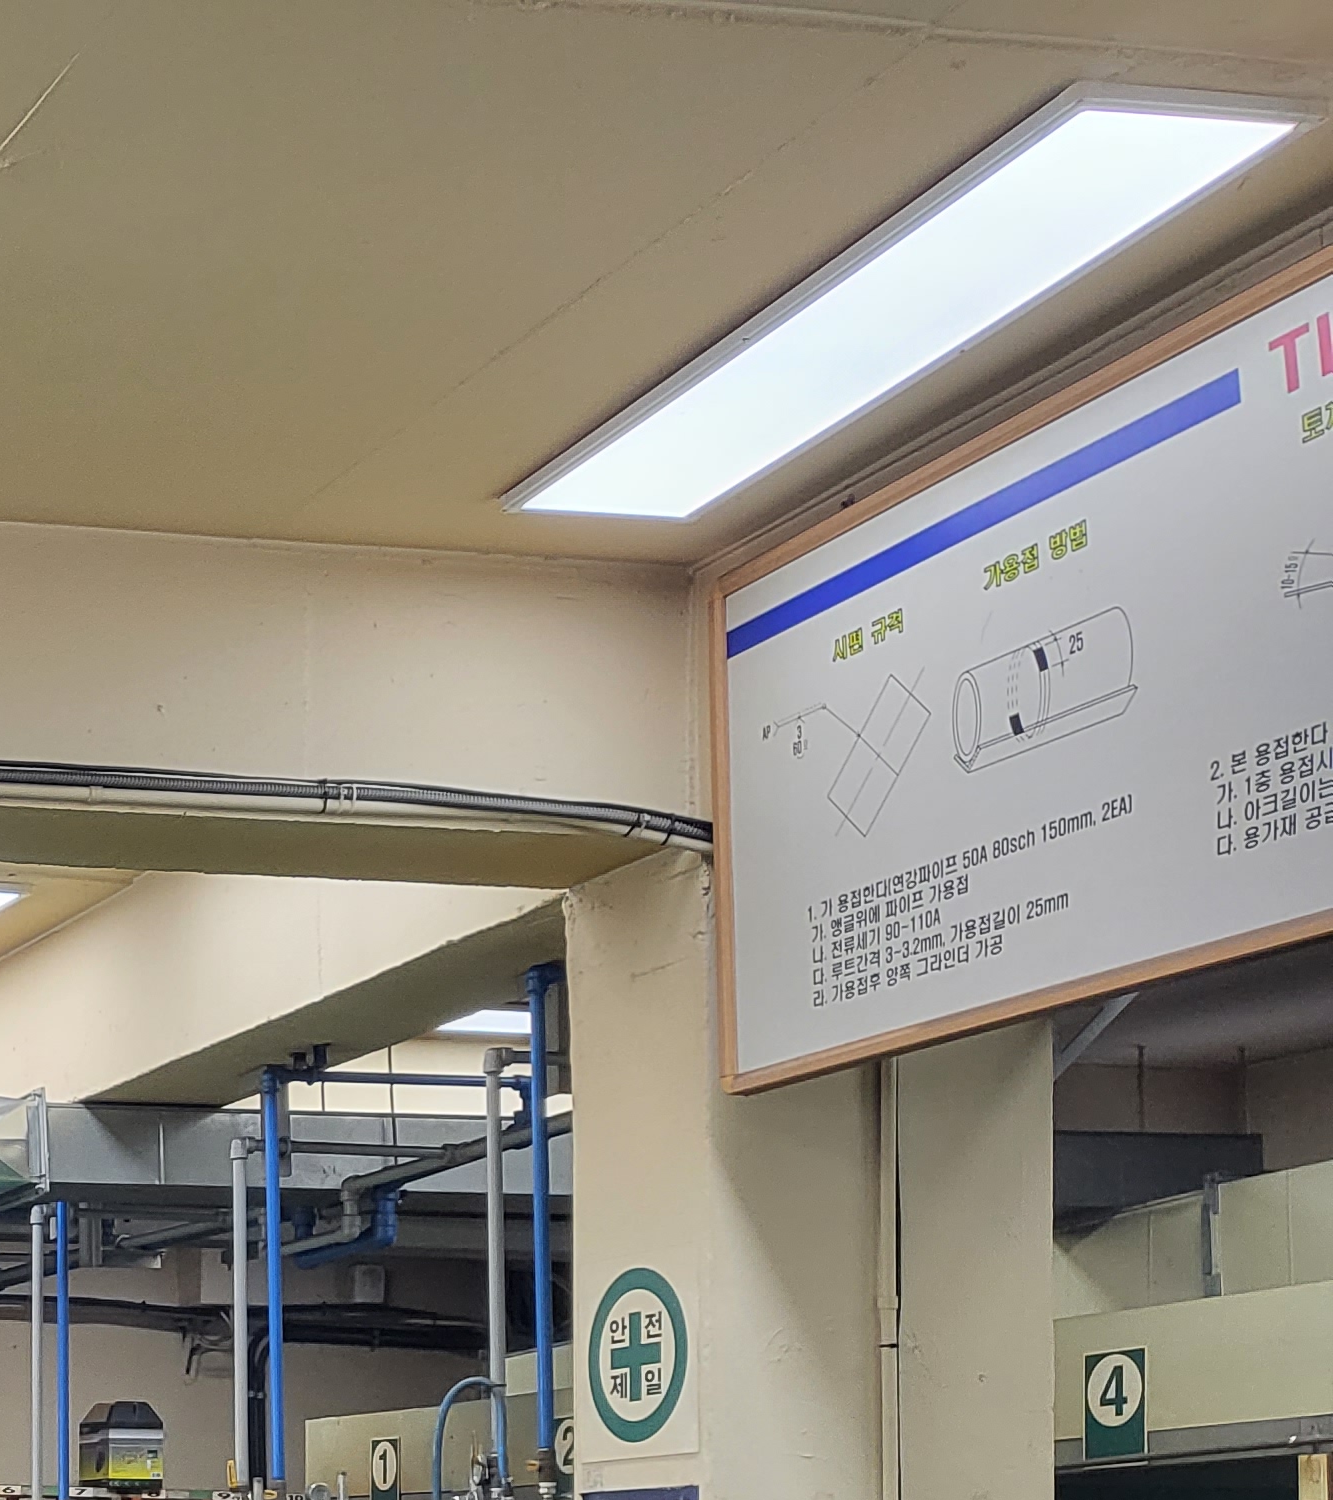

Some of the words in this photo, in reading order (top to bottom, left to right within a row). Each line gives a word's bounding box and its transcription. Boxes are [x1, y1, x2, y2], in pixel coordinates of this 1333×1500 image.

[1268, 311, 1333, 395] TI
[983, 543, 1039, 591] 가용접
[1049, 519, 1088, 560] 방법
[832, 628, 864, 662] 시편
[870, 608, 904, 645] 규격
[1068, 631, 1084, 655] 25
[1210, 760, 1224, 781] 2.
[1231, 750, 1247, 775] 본
[1255, 721, 1328, 767] 용접한다
[1217, 781, 1237, 805] 가.
[1217, 807, 1237, 830] 나.
[1244, 778, 1333, 821] 아크길이는
[1217, 834, 1237, 856] 다.
[1244, 813, 1297, 849] 용가재
[807, 906, 817, 922] 1.
[962, 845, 988, 870] 50A
[992, 829, 1035, 859] 80sch
[1041, 811, 1096, 843] 150mm,
[812, 923, 826, 942] 가.
[831, 905, 880, 938] 앵글위에
[886, 890, 924, 919] 파이프
[929, 874, 969, 903] 가용접
[812, 948, 826, 963] 나.
[831, 927, 880, 959] 전류세기
[813, 967, 826, 986] 다.
[831, 949, 880, 981] 루트간격
[950, 899, 1020, 943] 가용접길이
[1026, 892, 1069, 921] 25mm
[832, 971, 881, 1003] 가용접후
[886, 961, 911, 987] 양쪽
[916, 945, 969, 978] 그라인더
[975, 933, 1003, 960] 가공
[1100, 1365, 1128, 1417] 4
[379, 1449, 388, 1485] 1
[563, 1425, 574, 1467] 2
